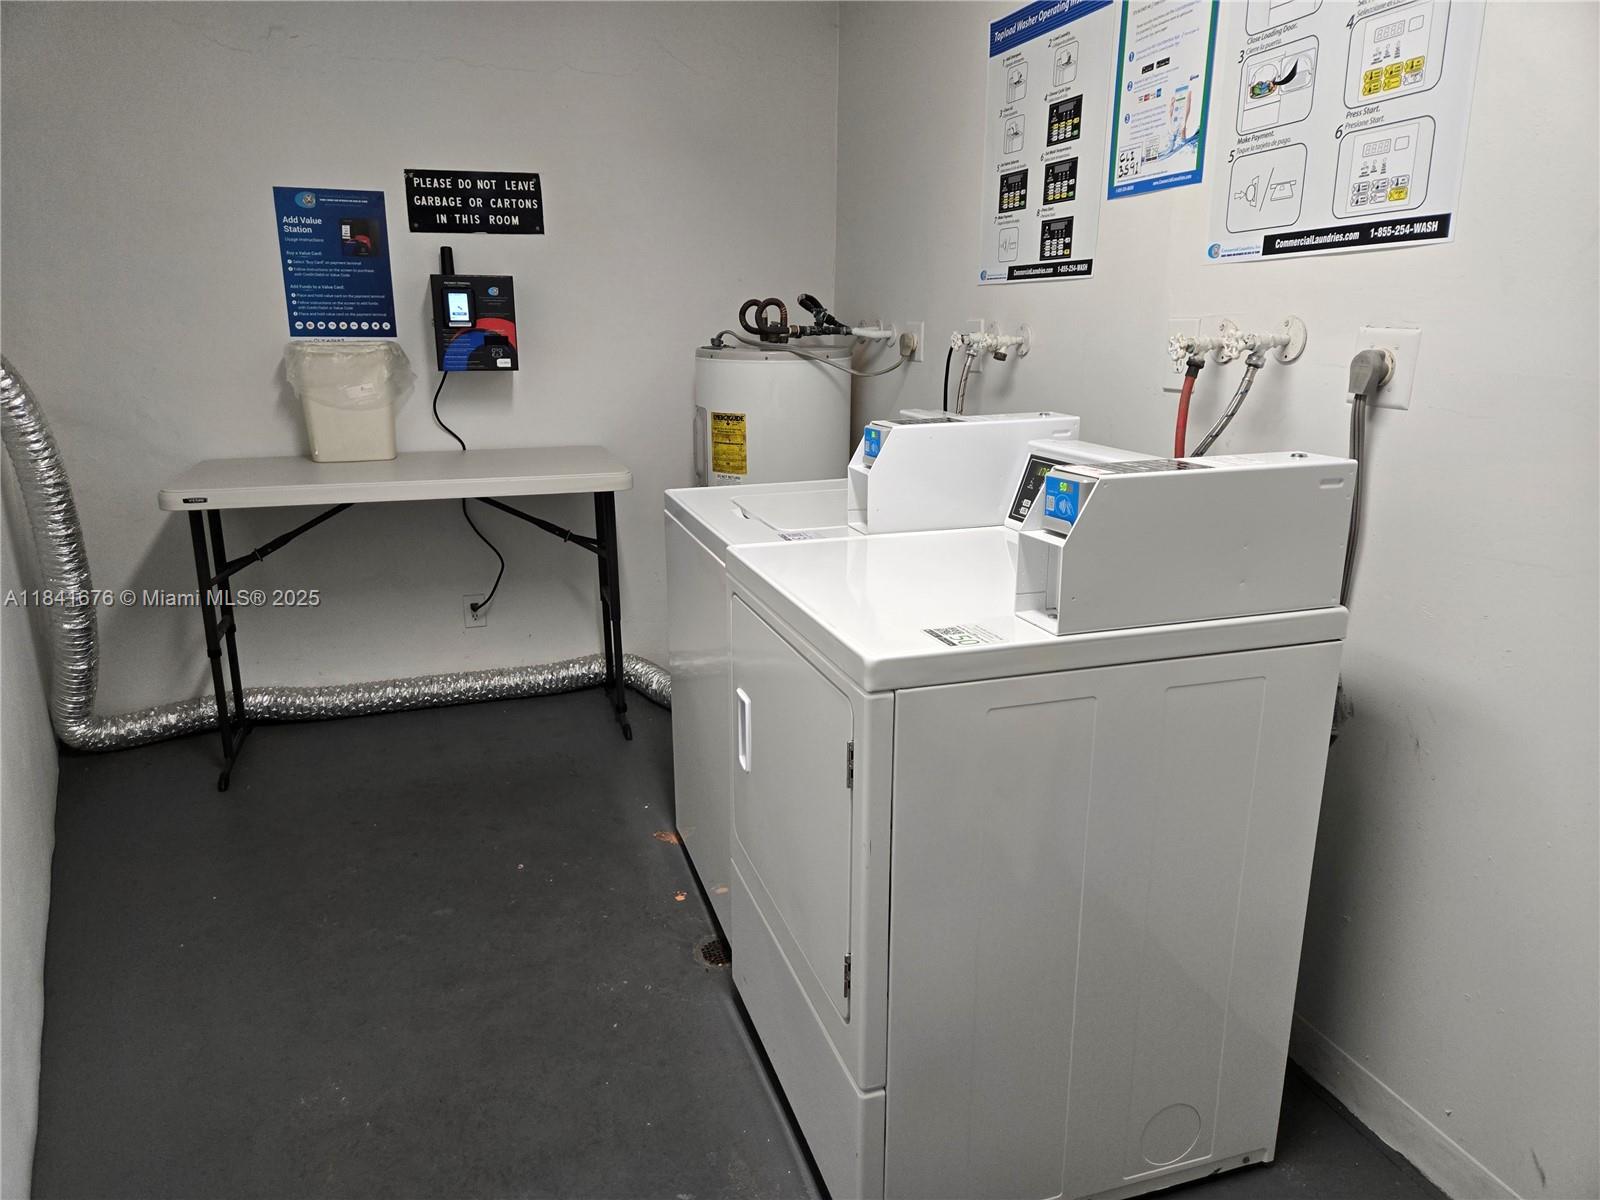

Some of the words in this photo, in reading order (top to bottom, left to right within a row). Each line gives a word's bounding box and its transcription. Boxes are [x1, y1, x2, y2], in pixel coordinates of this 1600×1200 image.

[994, 23, 1016, 42] Topload
[1017, 14, 1038, 32] Washer
[1038, 0, 1069, 22] Operating
[1345, 14, 1355, 29] 4
[1047, 38, 1053, 48] 2
[1246, 35, 1261, 45] Close
[1261, 28, 1283, 40] Loading
[1238, 49, 1245, 63] 3
[1345, 110, 1362, 120] Press
[1362, 105, 1381, 116] Start.
[1344, 119, 1369, 130] Presione
[1335, 124, 1345, 140] 6
[1236, 137, 1251, 145] Make
[1040, 152, 1045, 162] 6
[1228, 149, 1236, 163] 5
[1118, 161, 1139, 178] 3591
[413, 177, 452, 189] PLEASE
[458, 179, 472, 189] DO
[477, 179, 497, 190] NOT
[505, 180, 535, 191] LEAVE
[414, 195, 462, 207] GARBAGE
[469, 197, 483, 208] OR
[490, 198, 538, 209] CARTONS
[436, 213, 447, 224] IN
[454, 214, 480, 224] THIS
[489, 215, 520, 226] ROOM
[1036, 208, 1041, 217] 8
[283, 215, 298, 224] Add
[300, 216, 323, 225] Value
[283, 225, 313, 234] Station
[1274, 231, 1360, 249] CommercialLaundries.com
[1369, 220, 1439, 239] 1-855-254-WASH
[1059, 481, 1068, 492] 50
